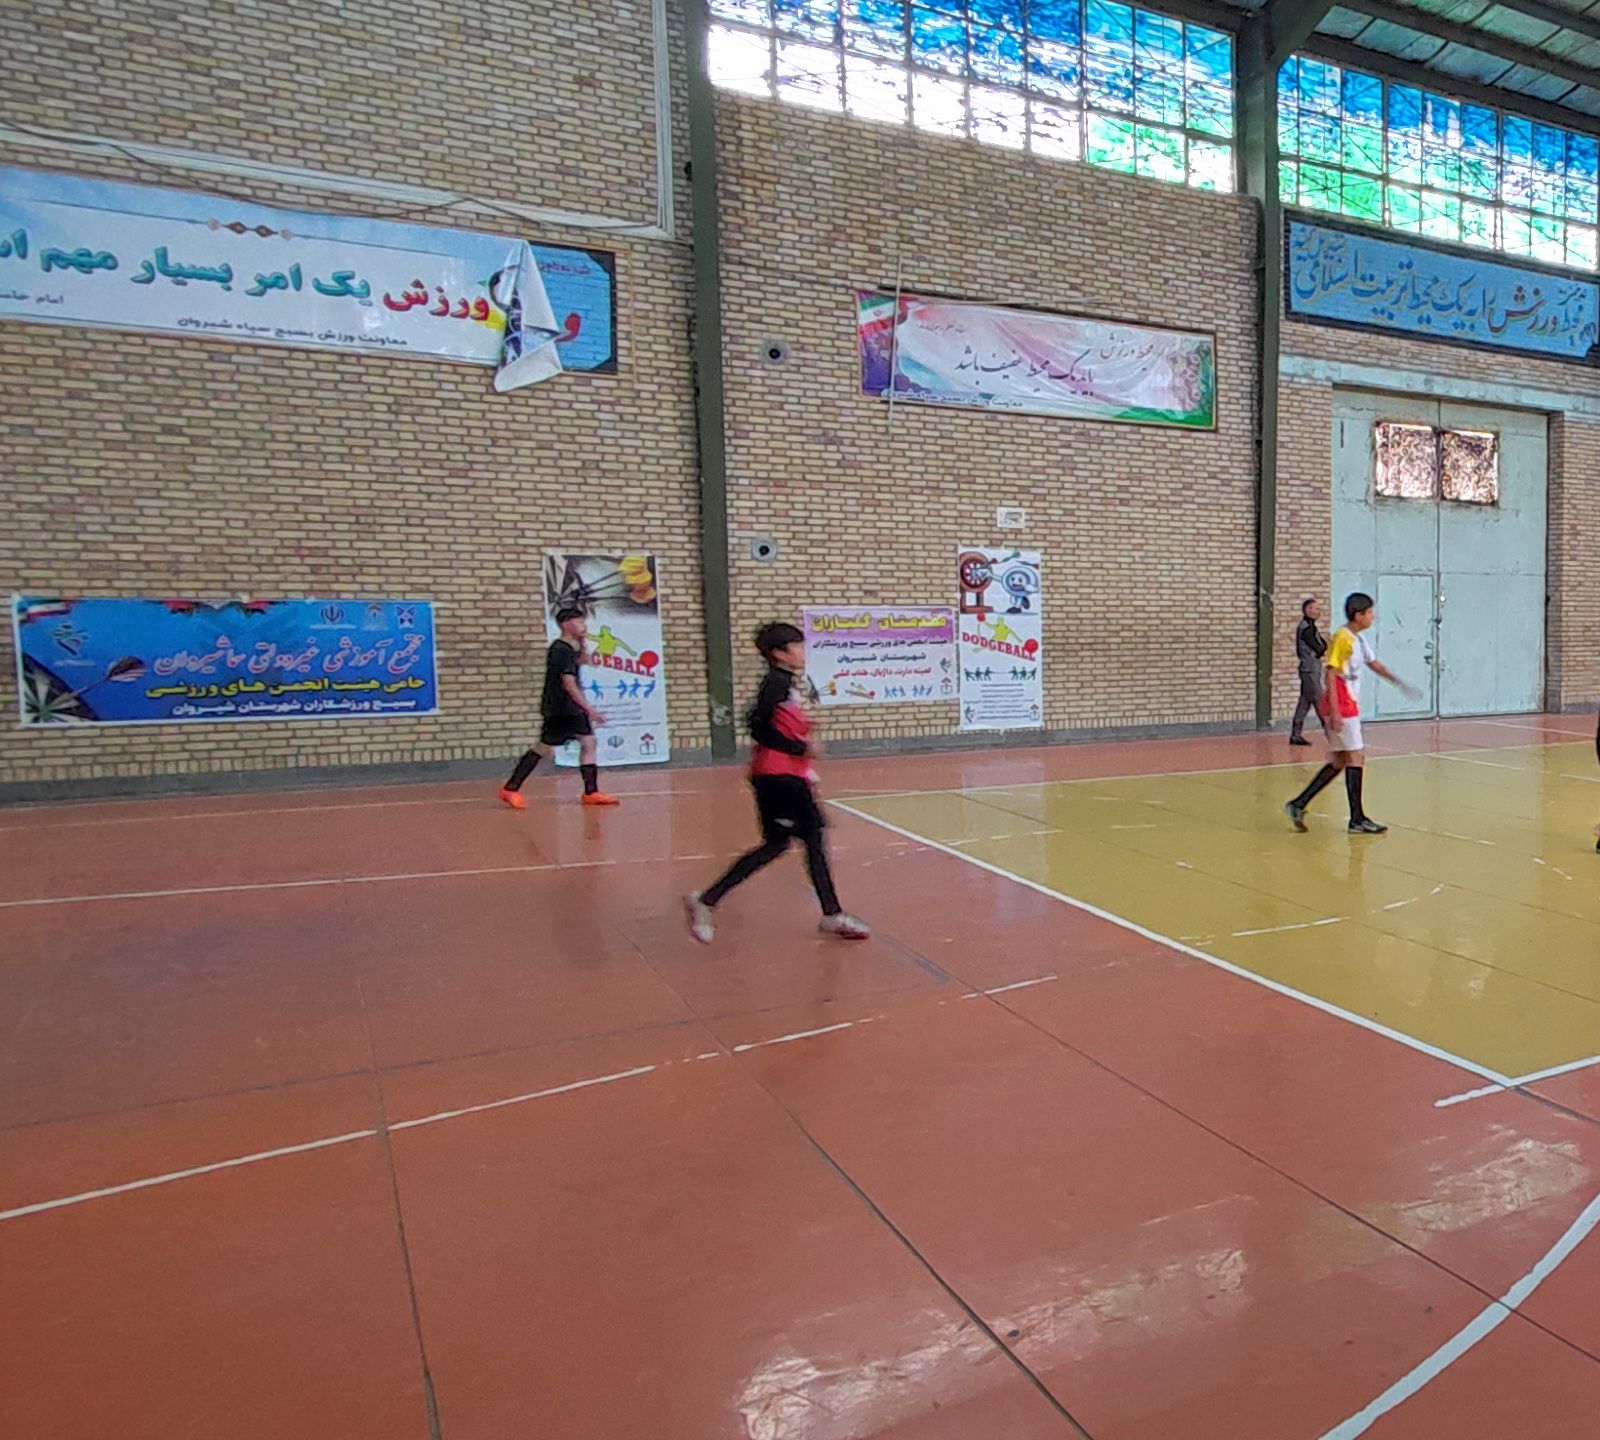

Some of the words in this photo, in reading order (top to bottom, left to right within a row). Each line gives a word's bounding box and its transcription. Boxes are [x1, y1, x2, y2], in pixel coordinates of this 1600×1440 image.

[39, 248, 119, 274] مهم
[130, 246, 233, 292] بسیار
[245, 262, 302, 297] امر
[312, 270, 373, 308] یک
[383, 278, 490, 321] ورزش
[1487, 285, 1559, 334] ورزش
[177, 316, 233, 330] شیروان
[236, 321, 271, 334] سپاه
[275, 326, 314, 339] بسیج
[317, 329, 355, 343] ورزش
[358, 333, 408, 347] معاونت
[954, 345, 980, 386] باشد
[879, 612, 947, 631] مقدمتان
[322, 636, 394, 674] آموزشی
[962, 632, 1035, 662] DODGEBALL
[591, 652, 655, 678] GEBALL
[145, 680, 218, 699] ورزشی
[222, 678, 265, 697] های
[268, 677, 329, 695] انجمن
[383, 676, 426, 694] حامی
[172, 701, 236, 716] شیروان
[238, 699, 302, 714] شهرستان
[304, 698, 370, 712] ورزشکاران
